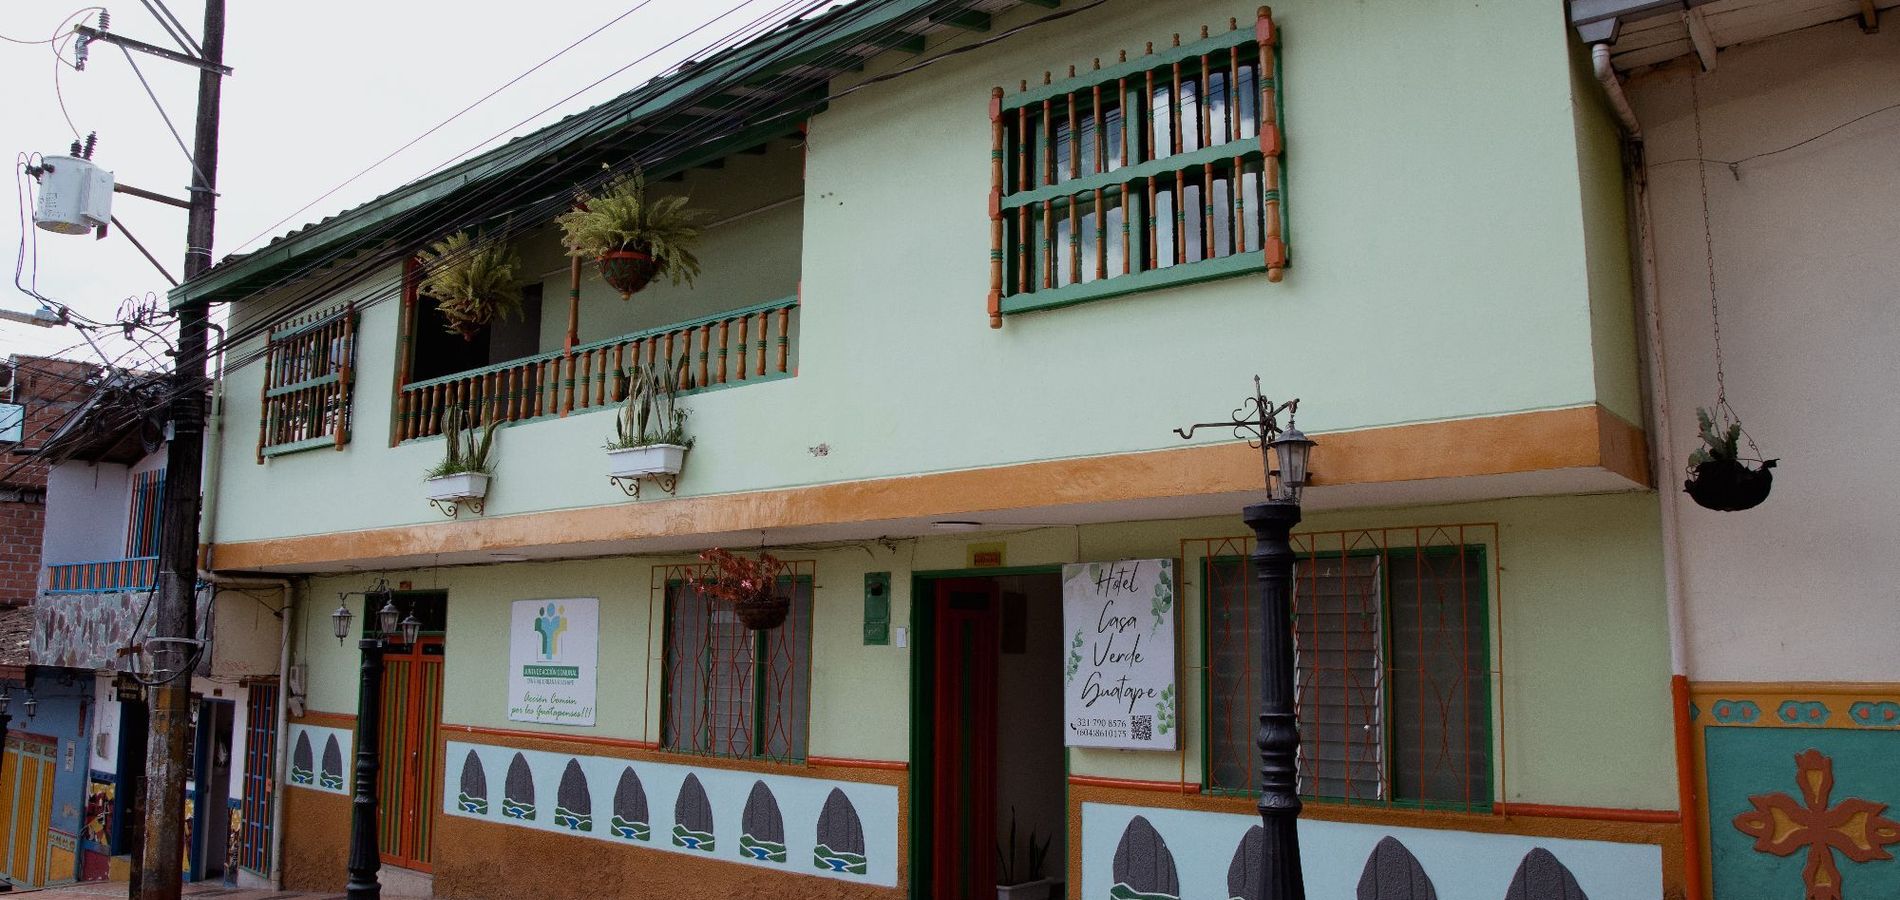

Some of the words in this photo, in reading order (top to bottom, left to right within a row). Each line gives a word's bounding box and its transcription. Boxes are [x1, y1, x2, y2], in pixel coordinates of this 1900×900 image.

[1095, 561, 1139, 597] Hotel
[1098, 600, 1136, 633] Casa
[1093, 633, 1144, 667] Verde
[1081, 671, 1157, 714] Guatape
[510, 707, 523, 717] por
[1077, 718, 1090, 727] 321
[1092, 718, 1107, 728] 790
[1108, 719, 1127, 729] 8576
